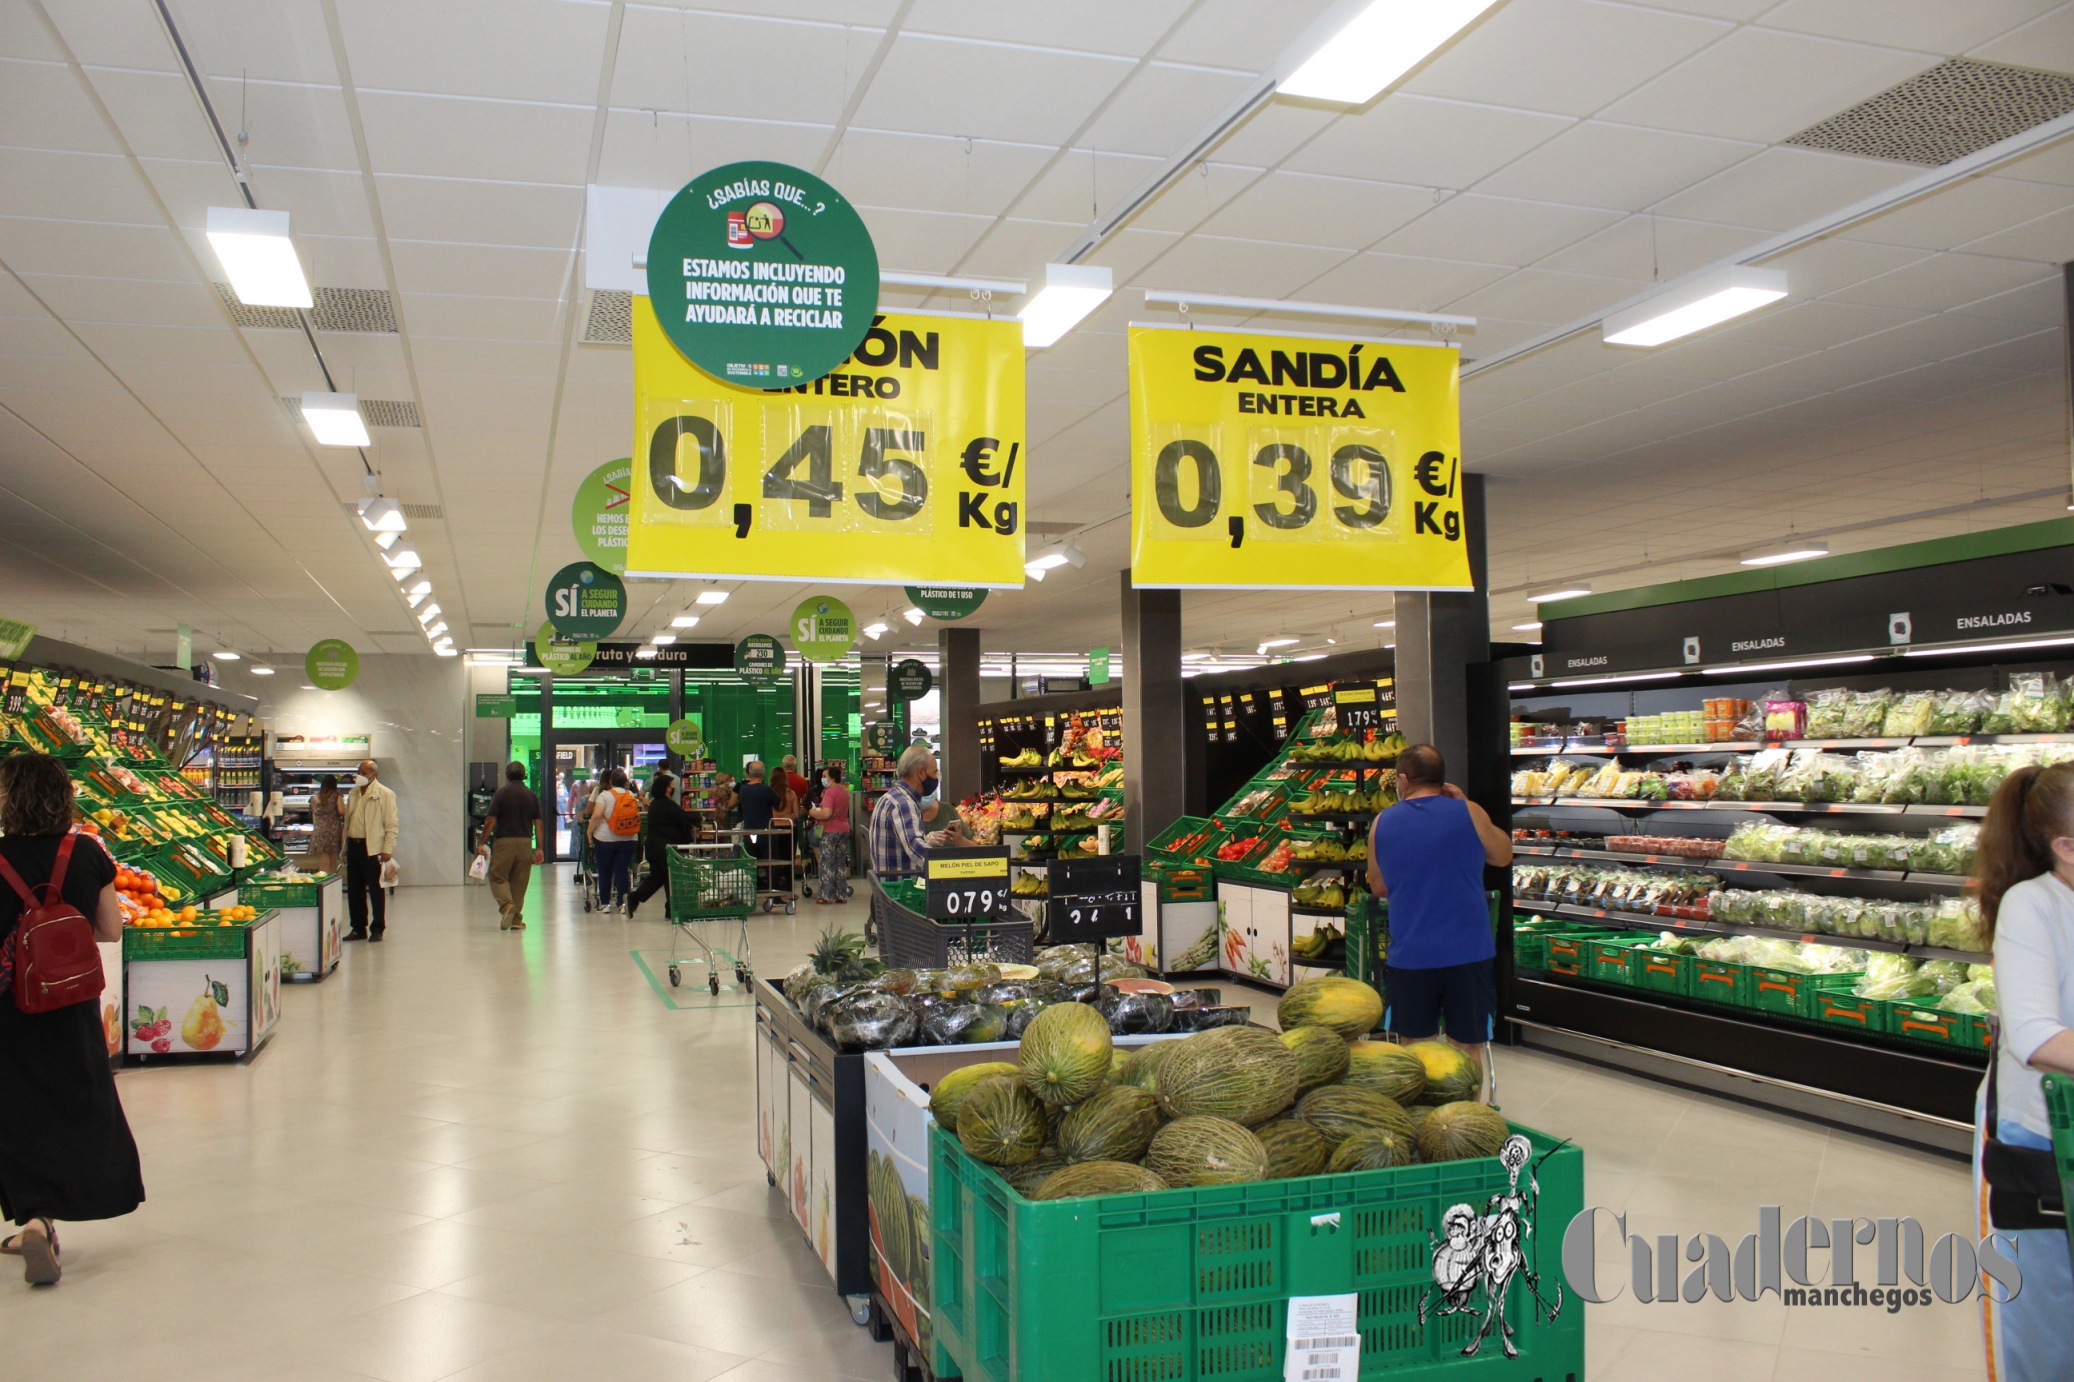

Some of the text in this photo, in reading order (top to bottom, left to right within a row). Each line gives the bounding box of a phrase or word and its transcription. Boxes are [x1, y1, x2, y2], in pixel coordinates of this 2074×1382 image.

[706, 178, 770, 210] ¿SABÍAS
[683, 258, 845, 284] ESTAMOS INCLUYENDO
[686, 282, 842, 306] INFORMACIÓN QUE TE
[686, 304, 842, 328] AYUDARÁ A RECICLAR
[1193, 344, 1406, 392] SANDÍA
[1238, 392, 1366, 419] ENTERA
[603, 466, 632, 484] ¿SABÍA
[650, 415, 928, 538] 0,45
[1155, 439, 1393, 548] 0,39
[597, 514, 623, 523] HEMOS
[958, 492, 1018, 536] Kg
[1414, 501, 1460, 541] Kg
[592, 526, 606, 535] LOS
[598, 536, 628, 547] PLÁSTIC
[555, 583, 580, 617] SÍ
[582, 589, 617, 599] A SEGUIR
[921, 589, 947, 598] PLÁSTICO
[581, 600, 617, 608] CUIDANDO
[590, 609, 617, 617] PLANETA
[798, 614, 817, 642] SÍ
[1957, 611, 2032, 630] ENSALADAS
[1732, 636, 1785, 652] ENSALADAS
[542, 652, 569, 660] PLÁSTICO
[579, 652, 591, 660] AÑO
[596, 649, 623, 660] ruta
[626, 651, 634, 663] y
[1568, 656, 1608, 668] ENSALADAS
[670, 730, 680, 744] SÍ
[999, 904, 1007, 912] kg
